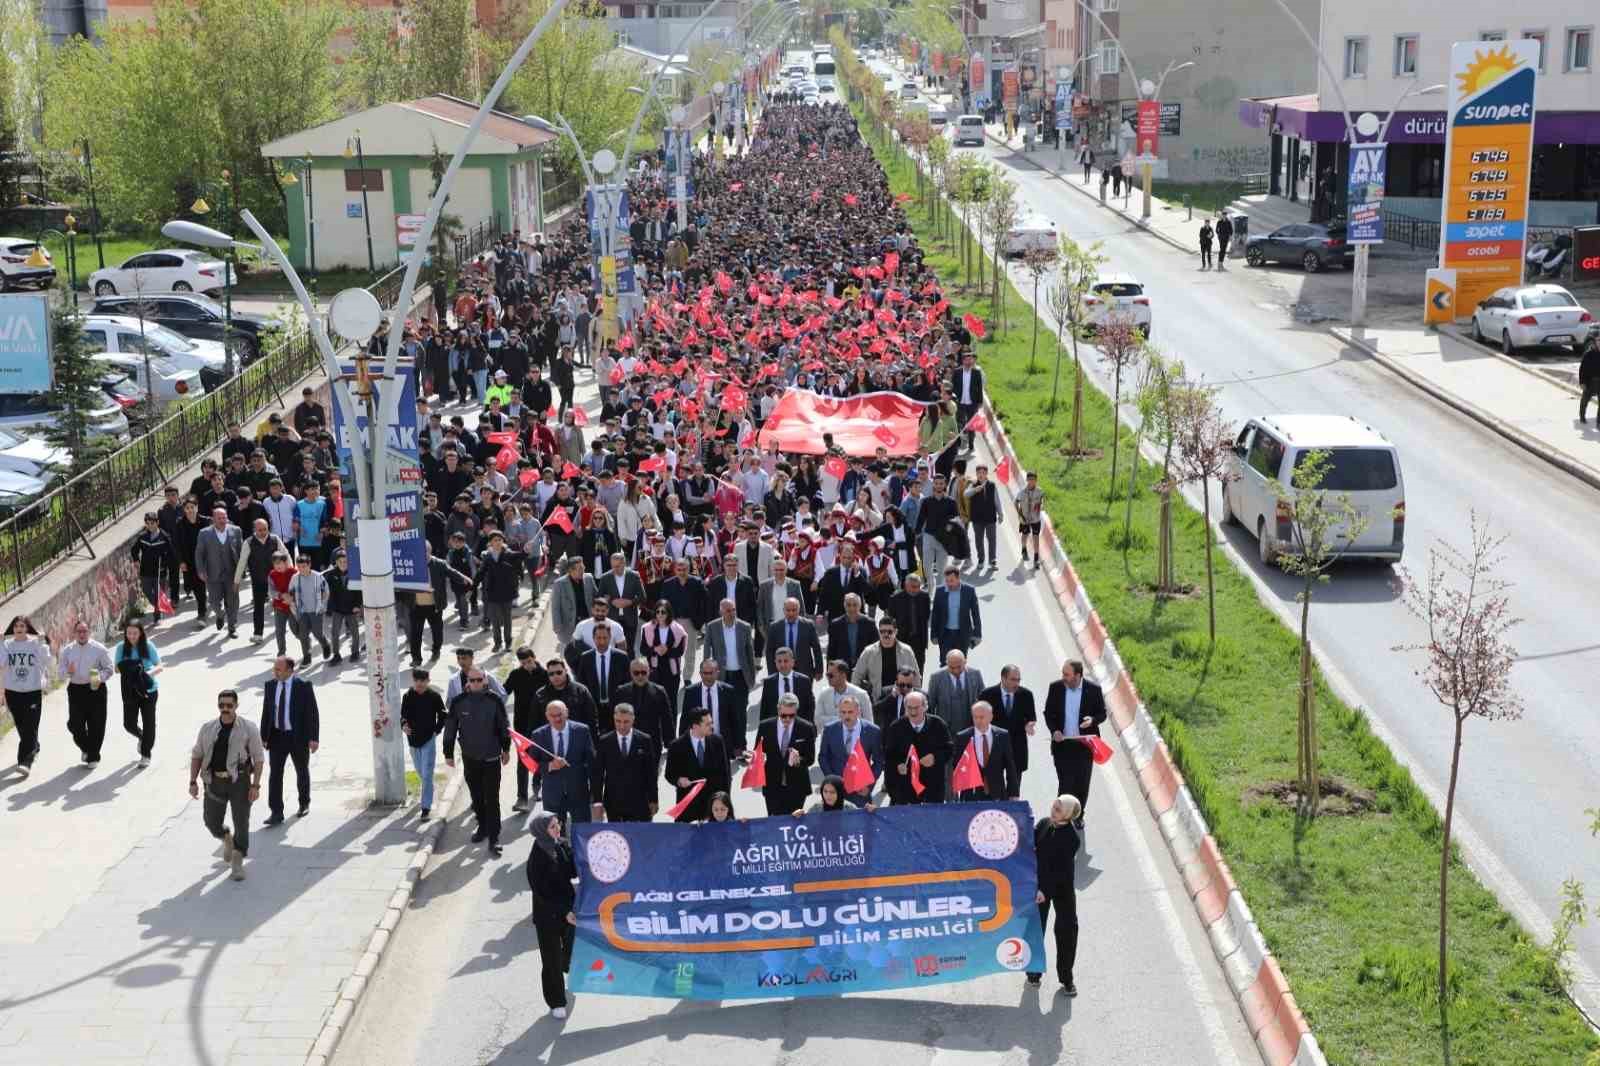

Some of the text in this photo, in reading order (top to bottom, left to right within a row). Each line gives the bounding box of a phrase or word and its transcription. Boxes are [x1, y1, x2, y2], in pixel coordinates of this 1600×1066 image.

[1464, 101, 1530, 121] sunpet
[1353, 150, 1383, 172] AY
[8, 653, 35, 666] NYC
[779, 825, 814, 842] T.C.
[732, 834, 865, 864] AĞRI VALİLİĞİ
[768, 860, 801, 873] EĞİTİM
[804, 854, 865, 869] MÜDÜRLÜĞÜ
[633, 889, 672, 903] AĞRI
[627, 910, 719, 935] BİLİM
[724, 907, 827, 933] DOLU
[819, 928, 881, 946] BİLİM
